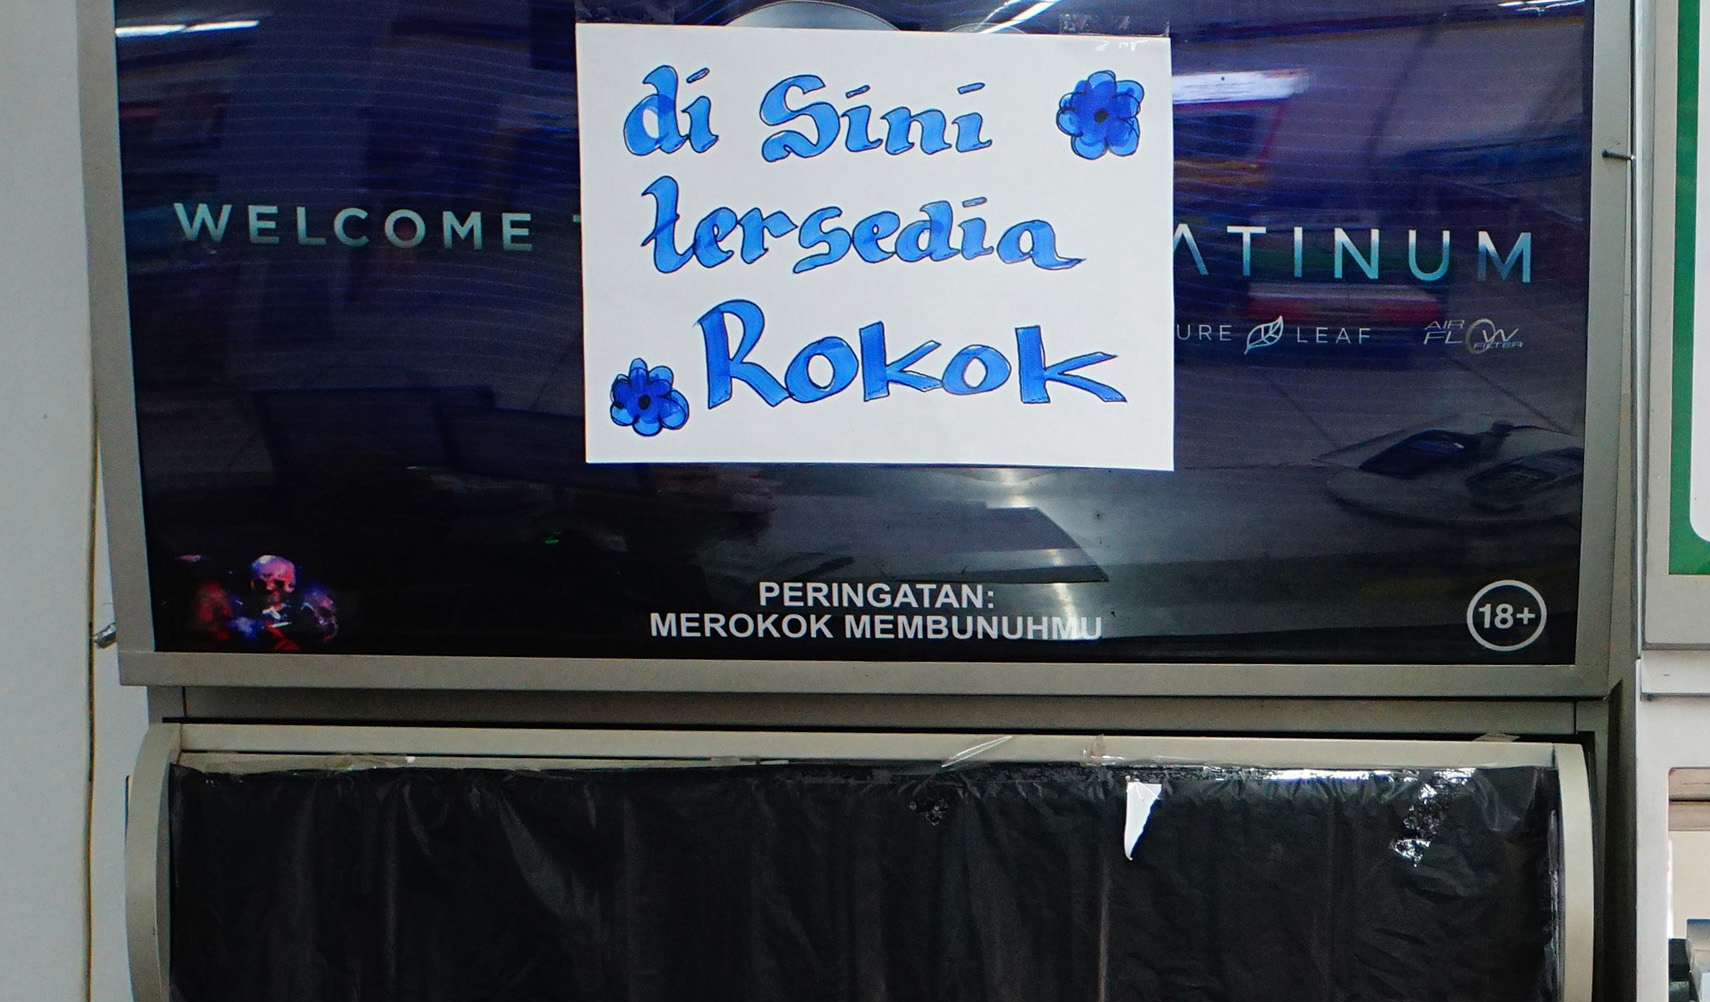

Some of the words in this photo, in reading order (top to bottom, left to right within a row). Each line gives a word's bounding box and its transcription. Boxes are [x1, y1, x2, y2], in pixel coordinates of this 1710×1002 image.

[623, 65, 719, 157] di
[760, 73, 992, 163] Sini
[174, 202, 533, 252] WELCOME
[1173, 223, 1531, 283] ATINUM
[694, 298, 1127, 408] Rokok
[1176, 322, 1232, 342] URE
[1297, 326, 1371, 346] LEAF
[759, 581, 995, 610] PERINGATAN:
[649, 612, 833, 639] MEROKOK
[844, 613, 1102, 640] MEMBUNUHMU
[1478, 602, 1537, 631] 18+
